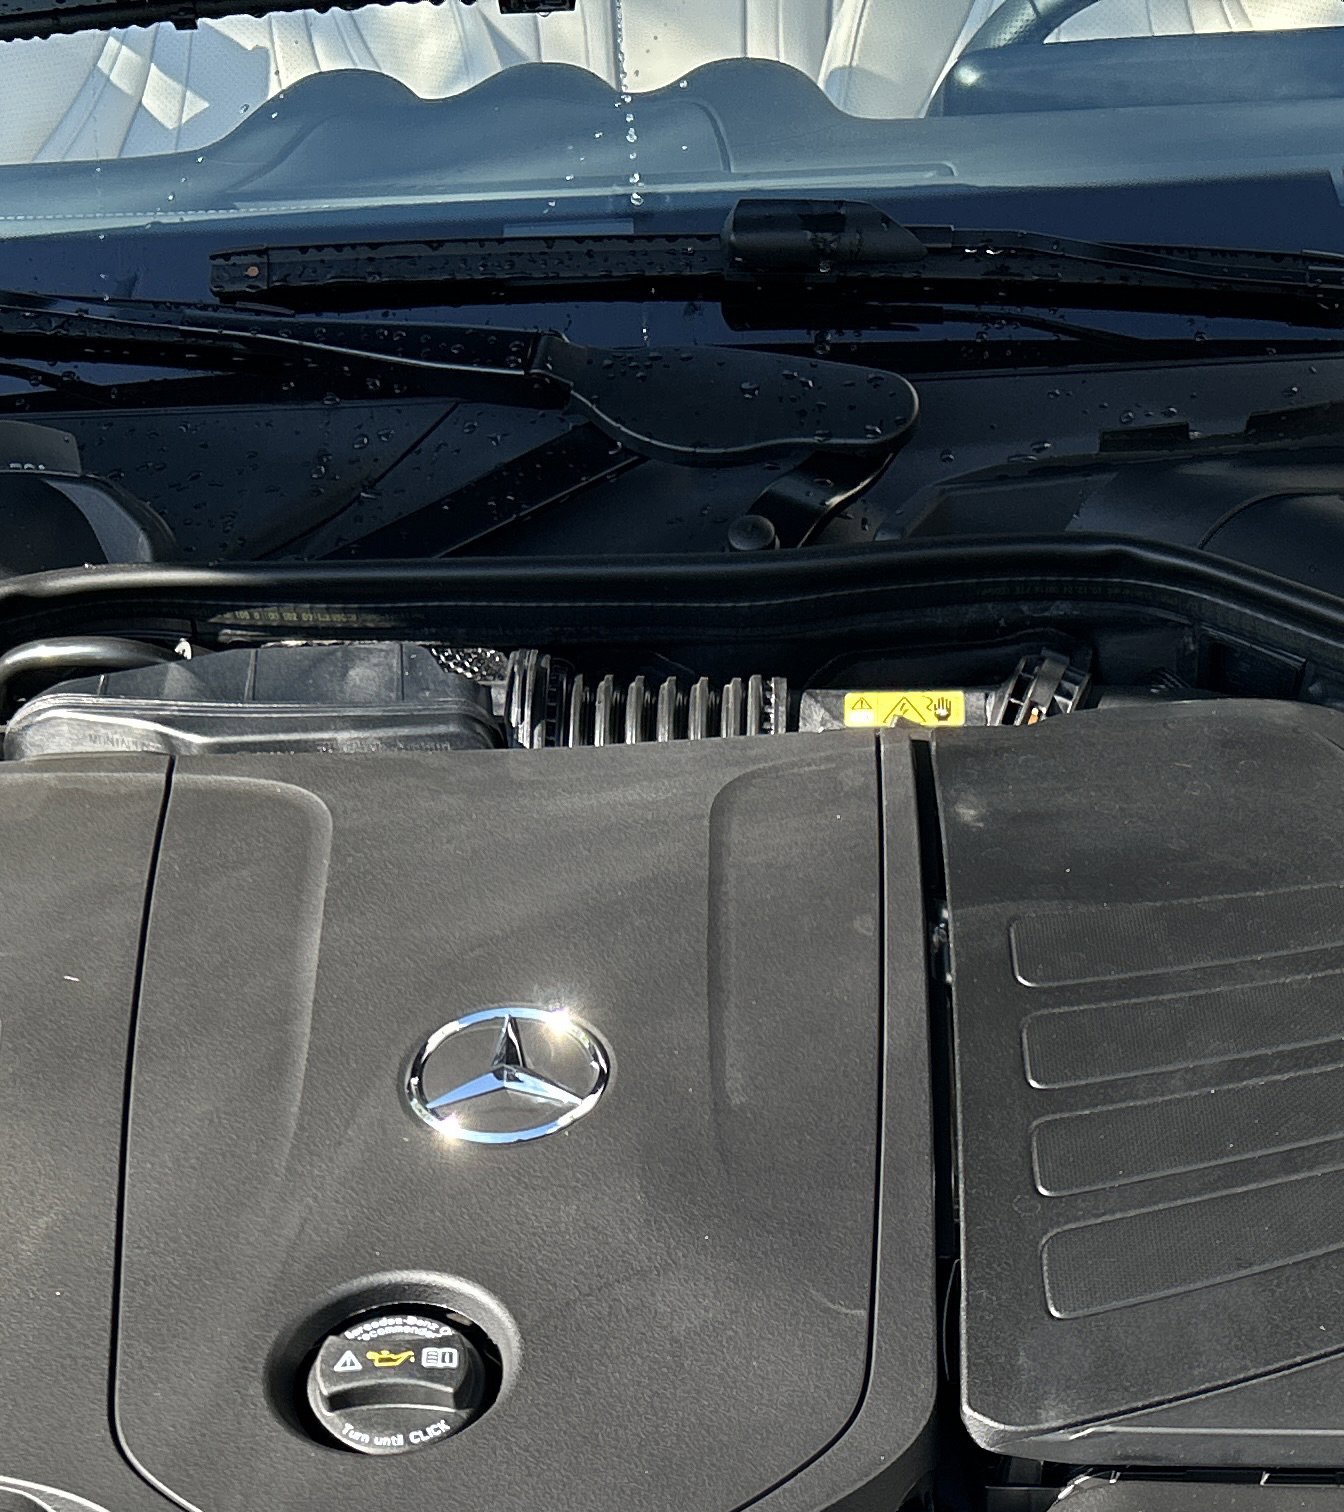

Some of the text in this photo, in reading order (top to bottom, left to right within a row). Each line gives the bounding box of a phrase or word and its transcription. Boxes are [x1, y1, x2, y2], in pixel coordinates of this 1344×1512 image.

[341, 1419, 451, 1447] Turn until CLICK
